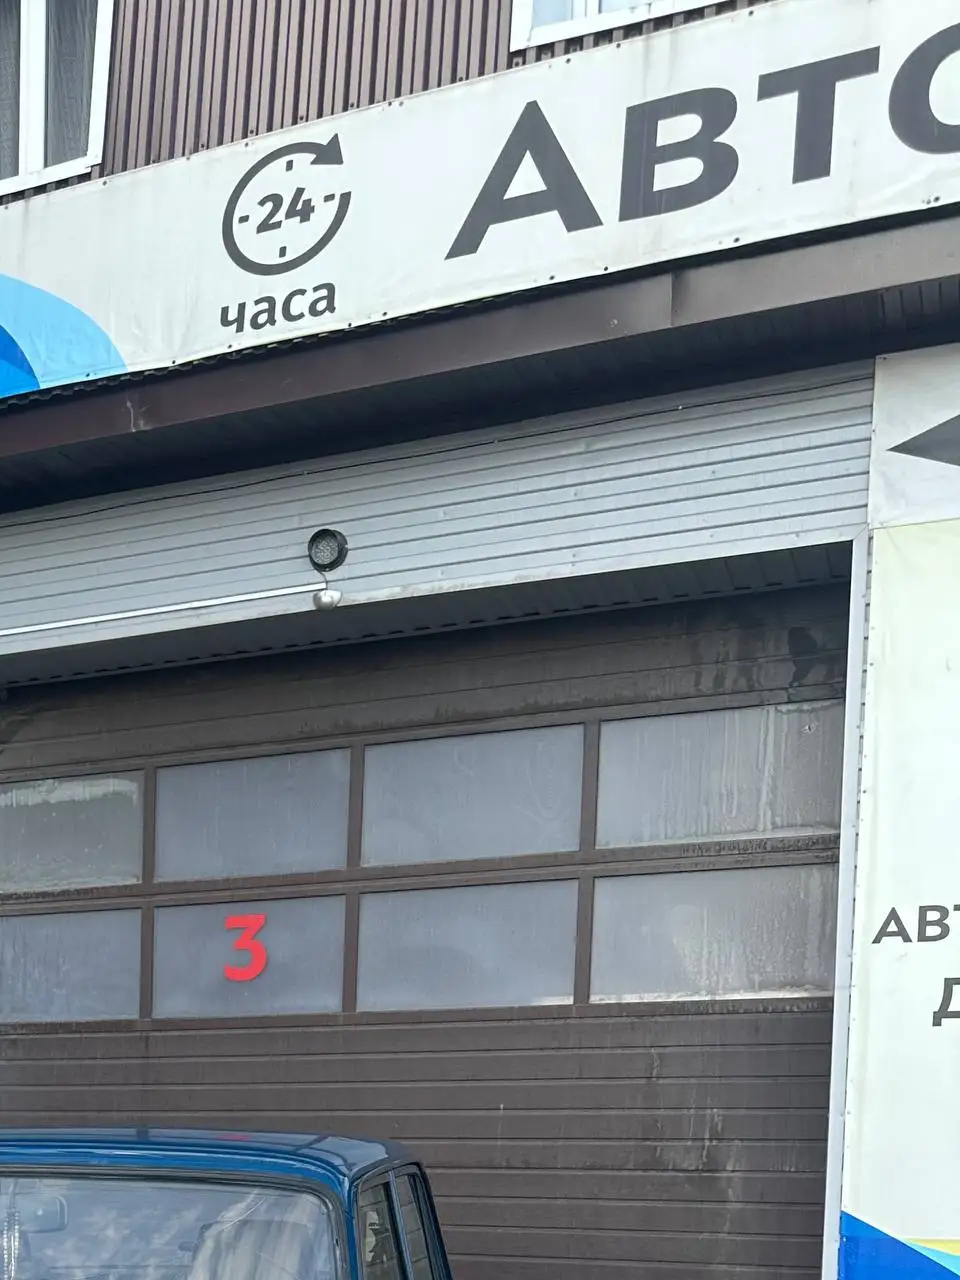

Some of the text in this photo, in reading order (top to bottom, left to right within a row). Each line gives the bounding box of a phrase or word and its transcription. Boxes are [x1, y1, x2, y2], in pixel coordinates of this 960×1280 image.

[255, 187, 315, 234] 24
[220, 282, 336, 333] часа
[224, 913, 268, 982] 3
[871, 904, 960, 944] АВ
